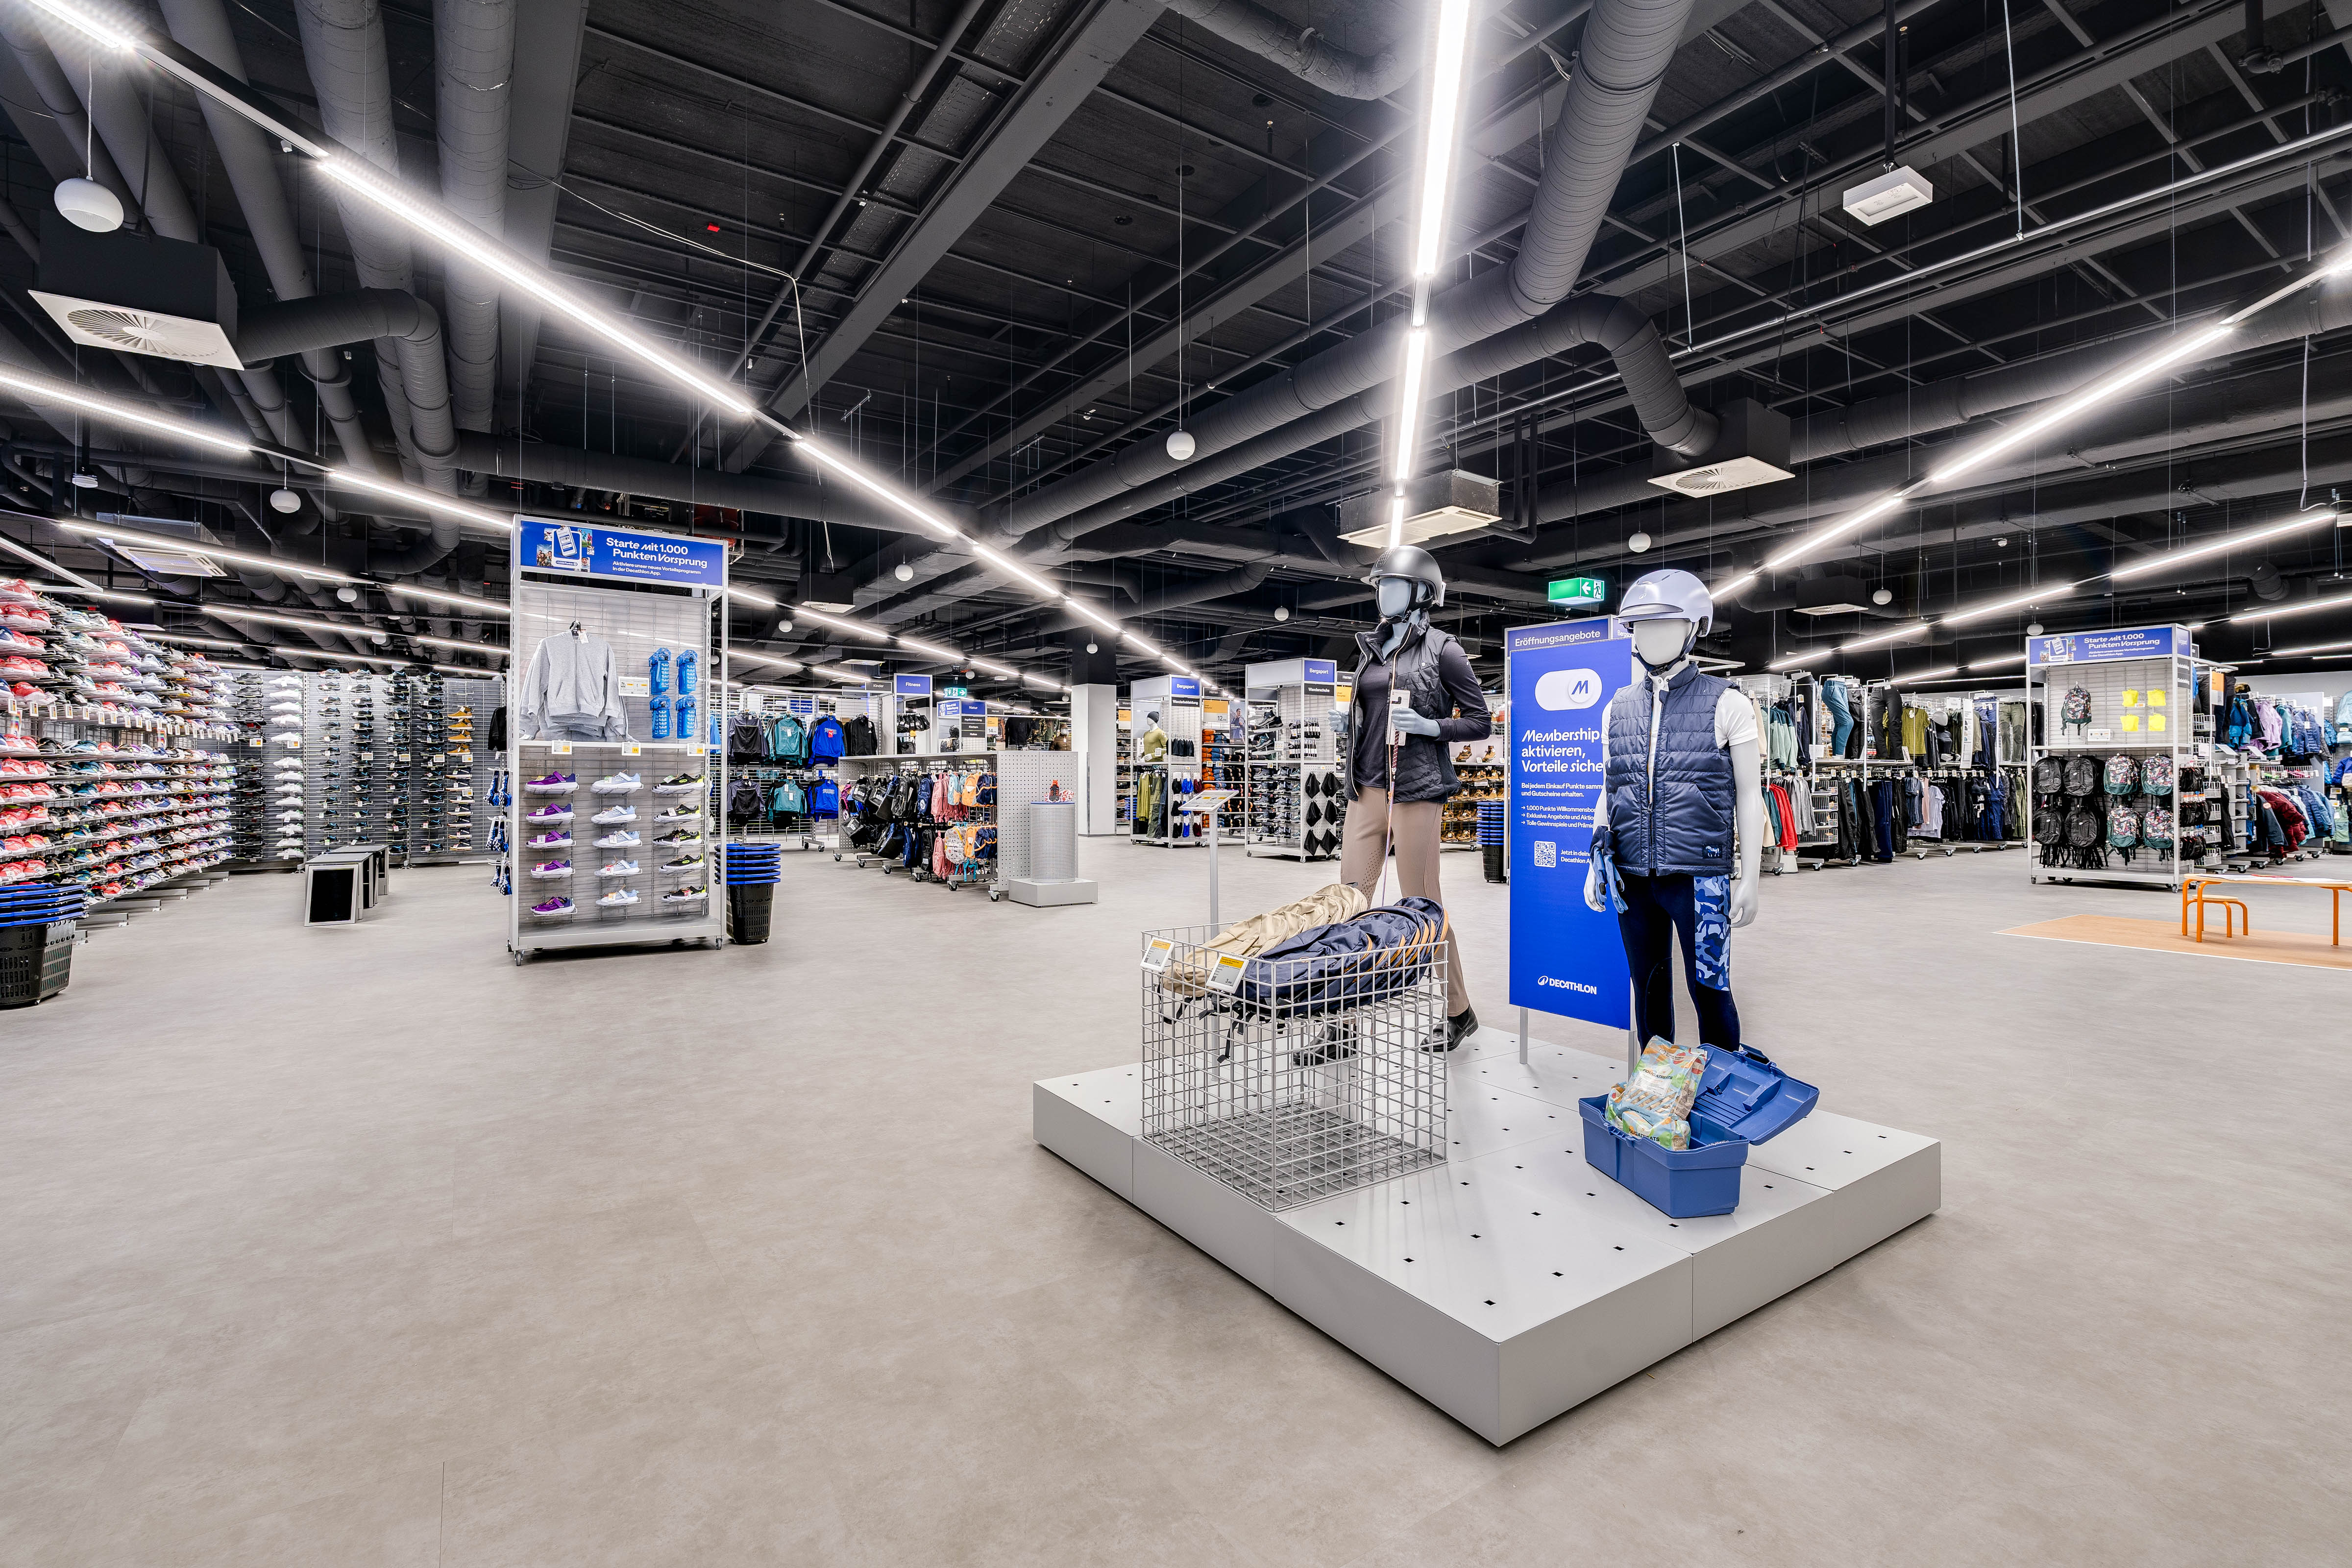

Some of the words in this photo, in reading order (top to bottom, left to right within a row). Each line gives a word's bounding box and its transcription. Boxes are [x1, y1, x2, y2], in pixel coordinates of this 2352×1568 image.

[606, 538, 639, 549] Starte
[641, 542, 659, 552] mit
[660, 544, 688, 555] 1.000
[613, 548, 657, 562] Punkten
[658, 553, 708, 569] Vorsprung
[662, 566, 701, 575] Vorteilsprogramm
[1515, 630, 1600, 646] Eröffnungsangebote
[1521, 727, 1600, 743] Membership
[1521, 744, 1586, 759] aktivieren,
[1521, 760, 1568, 772] Vorteile
[1549, 978, 1597, 995] DECATHLON
[1642, 1068, 1673, 1079] FOUGATREATS
